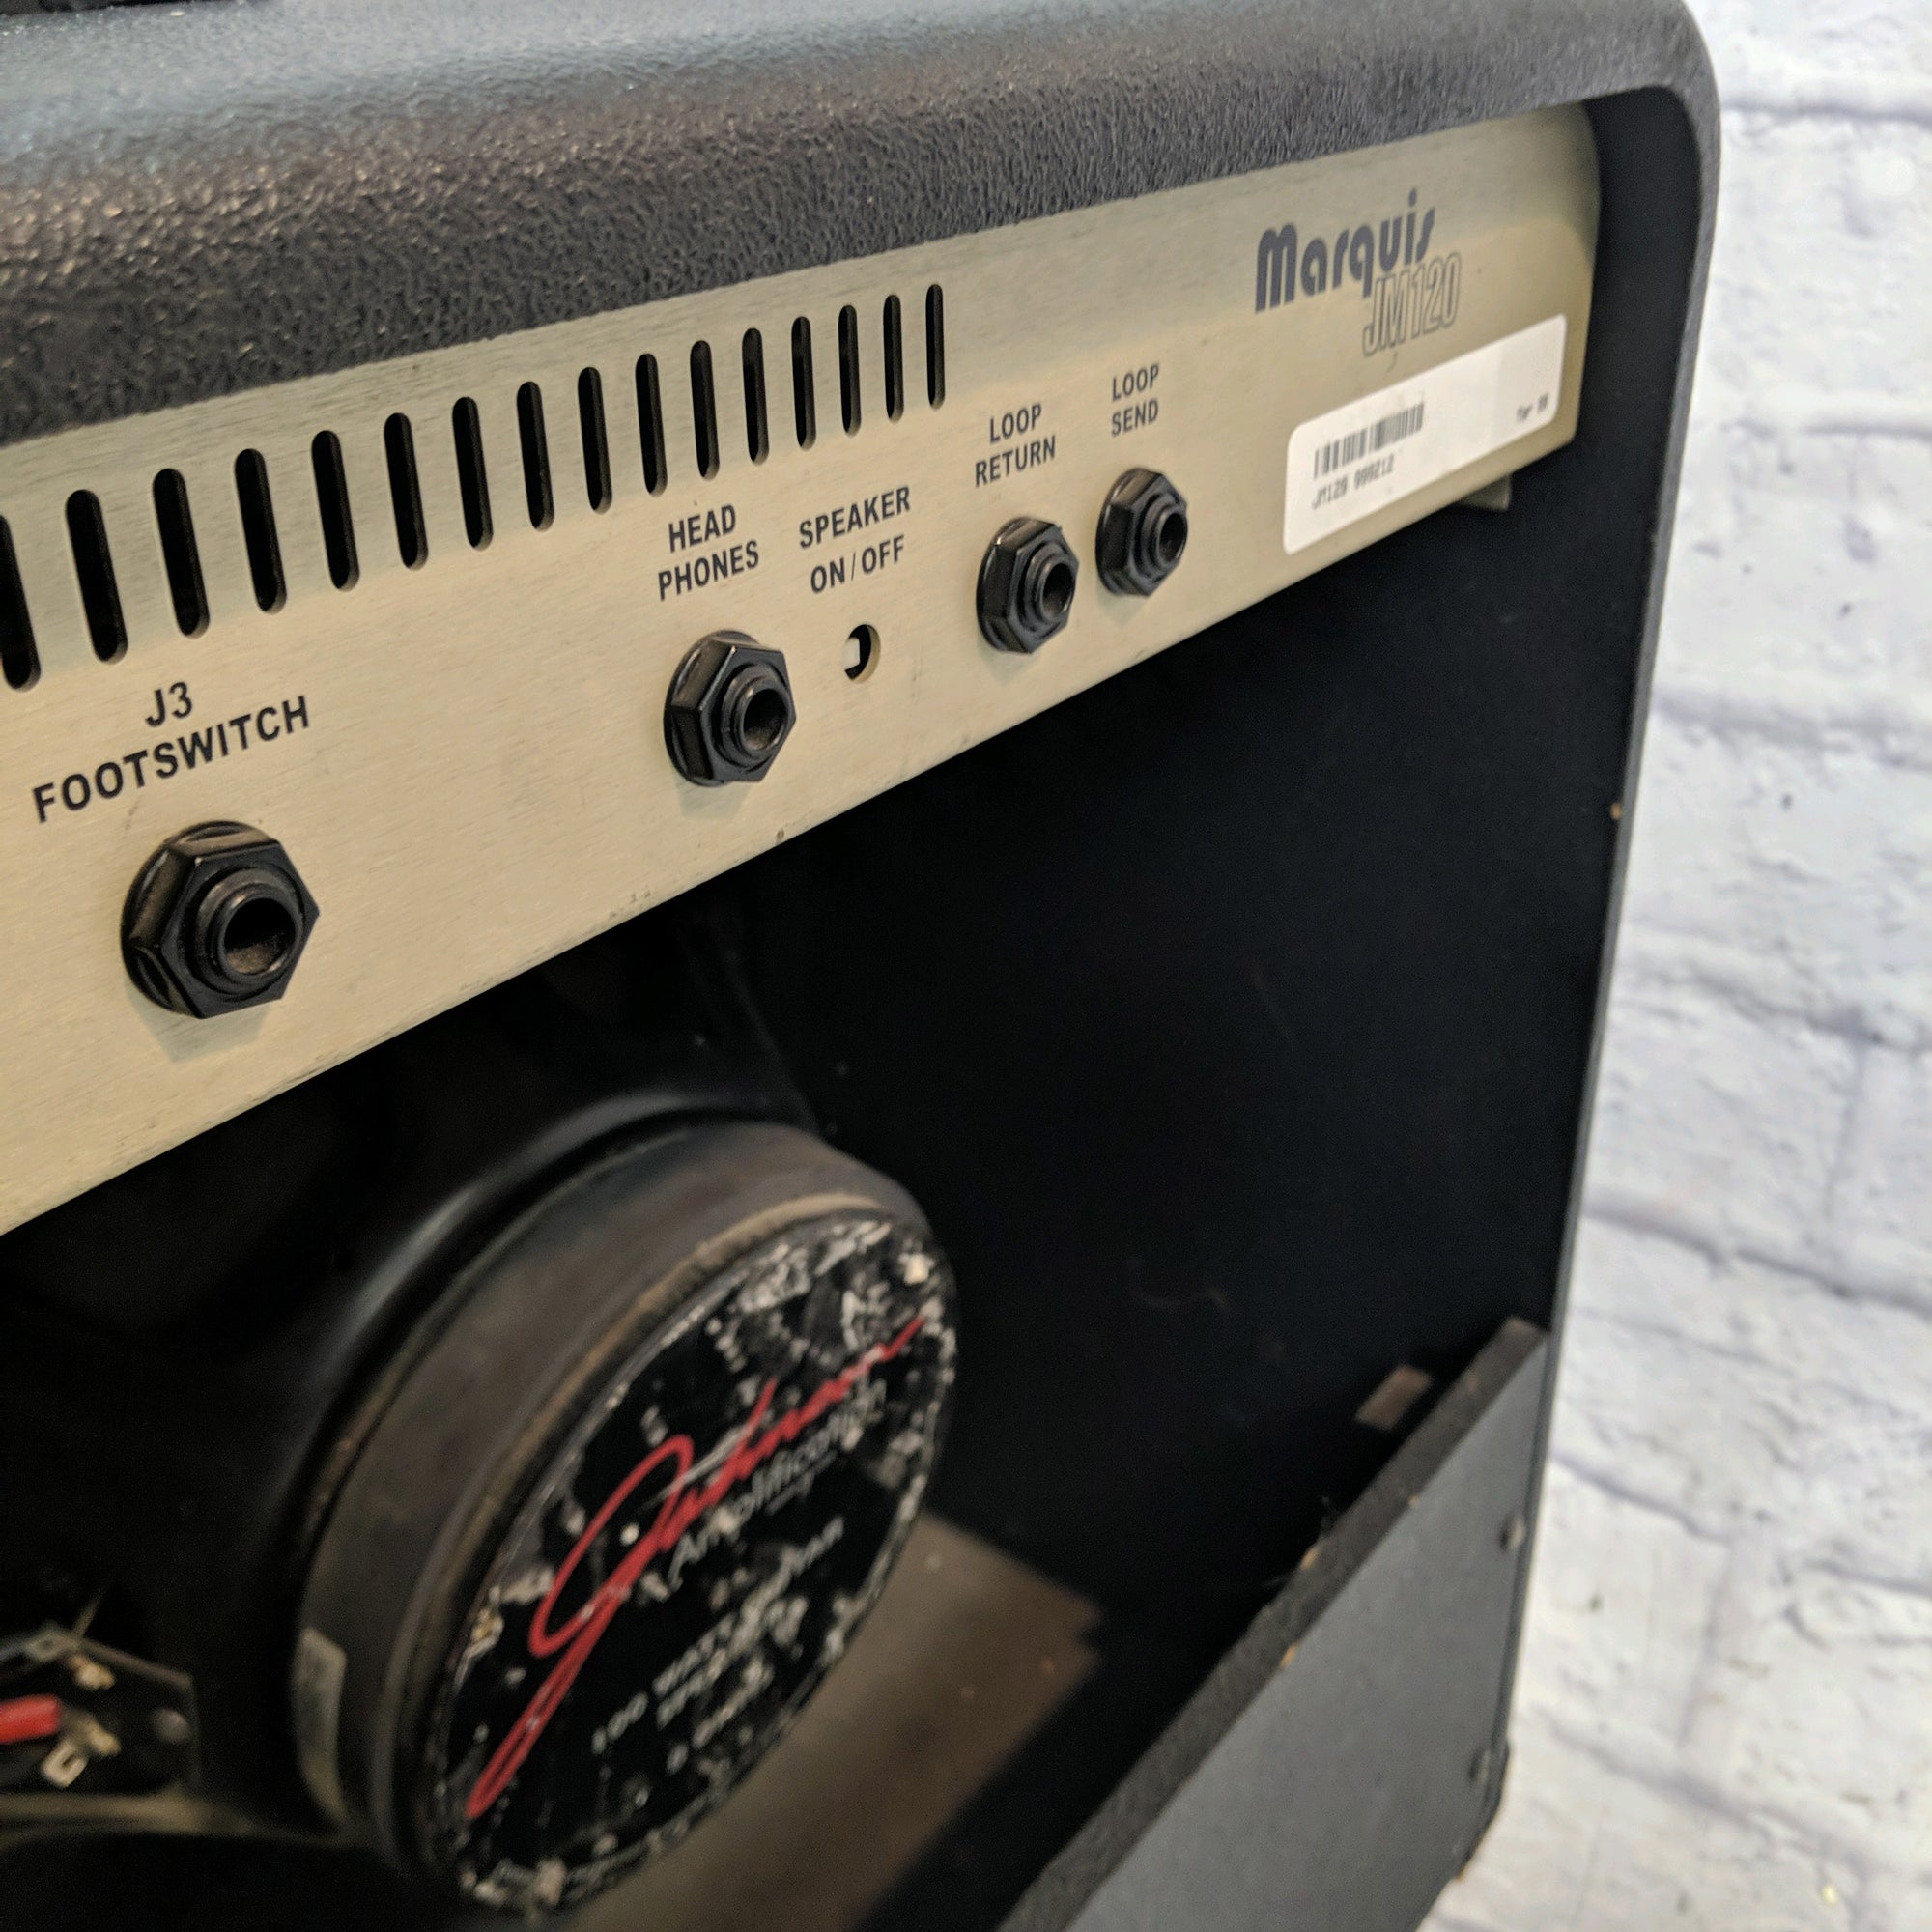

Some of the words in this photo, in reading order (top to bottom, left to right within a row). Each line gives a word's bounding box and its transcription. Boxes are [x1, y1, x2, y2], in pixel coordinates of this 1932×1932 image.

[1256, 186, 1436, 314] Marquis
[1362, 251, 1463, 357] JM120
[1111, 362, 1160, 402] LOOP
[988, 402, 1043, 445] LOOP
[1110, 398, 1159, 438] SEND
[975, 434, 1057, 488] RETURN
[668, 503, 737, 554] HEAD
[798, 485, 912, 549] SPEAKER
[657, 540, 760, 601] PHONES
[145, 680, 194, 727] J3
[32, 694, 310, 823] FOOTSWITCH
